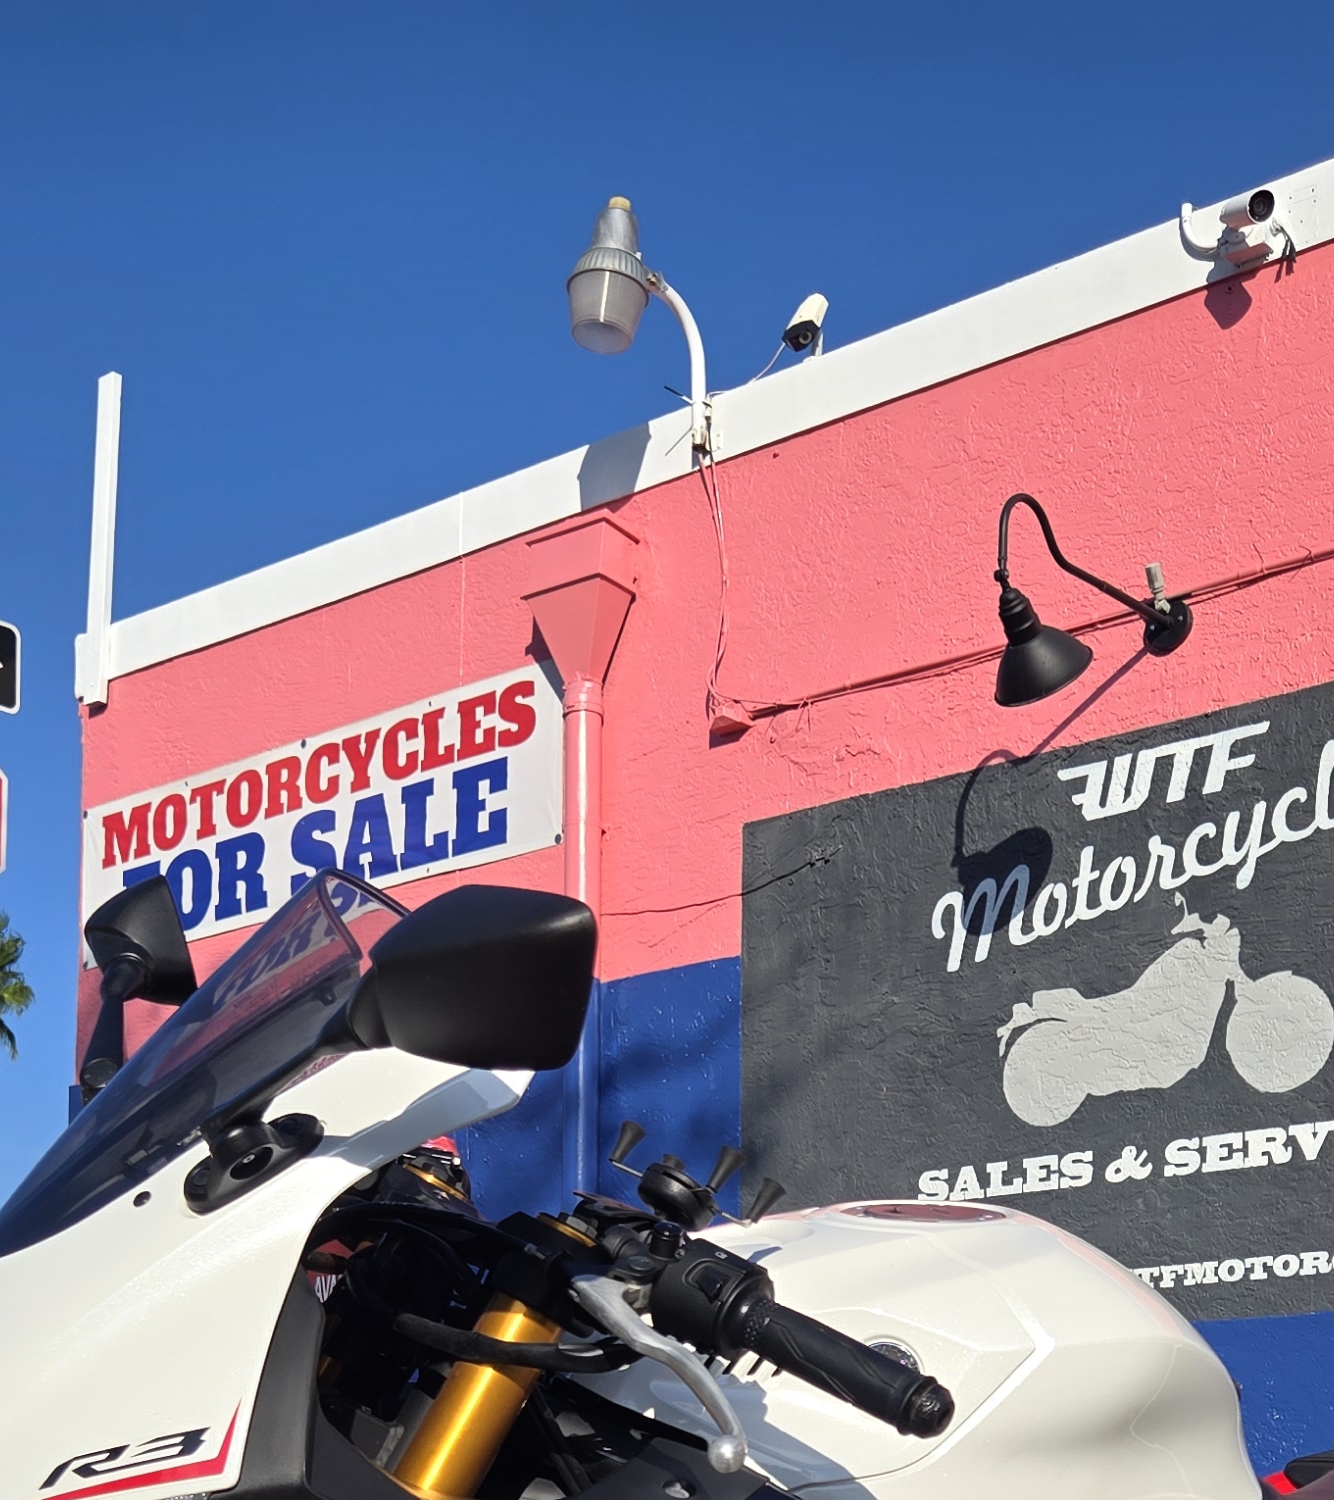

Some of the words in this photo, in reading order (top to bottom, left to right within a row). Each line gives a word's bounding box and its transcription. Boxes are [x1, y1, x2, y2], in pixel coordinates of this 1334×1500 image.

[102, 681, 537, 869] MOTORCYCLES
[1057, 720, 1271, 821] WTF
[291, 756, 509, 892] SALE
[917, 1150, 1094, 1202] SALES
[1104, 1145, 1153, 1183] &
[38, 1426, 211, 1491] R3
